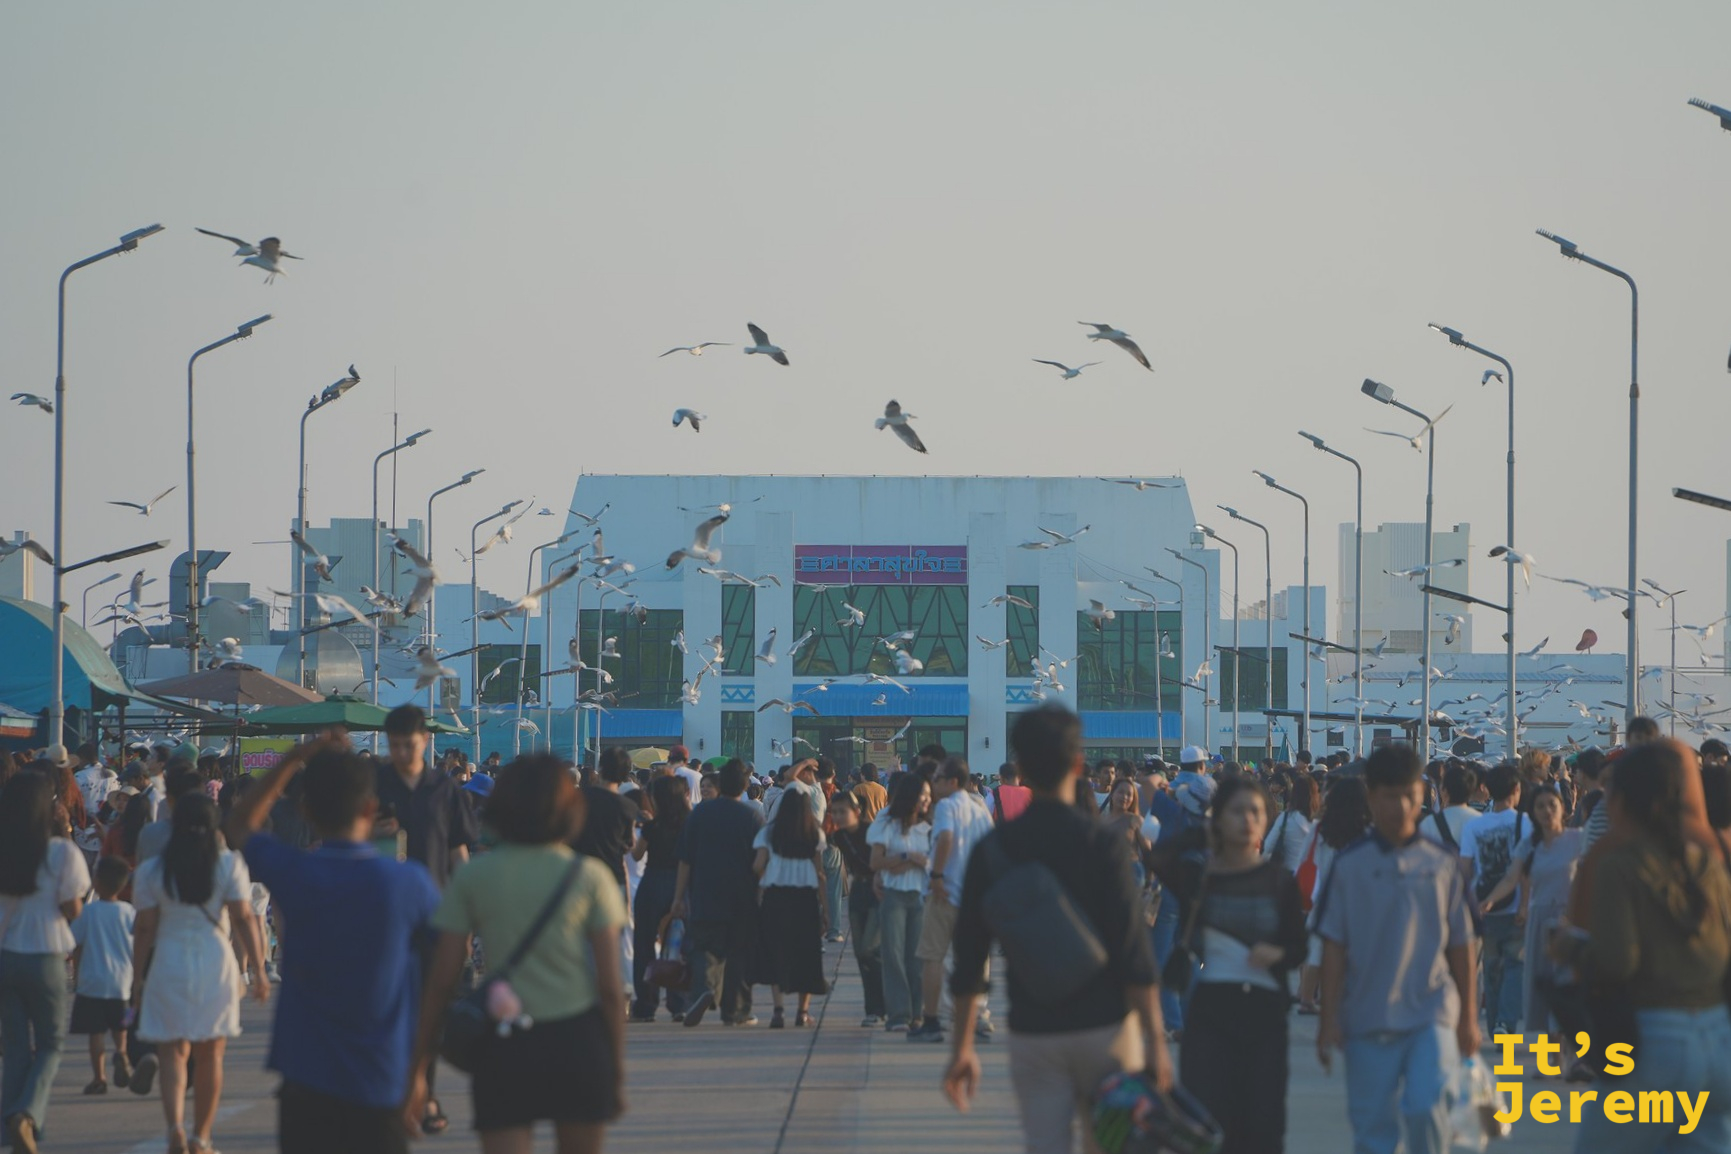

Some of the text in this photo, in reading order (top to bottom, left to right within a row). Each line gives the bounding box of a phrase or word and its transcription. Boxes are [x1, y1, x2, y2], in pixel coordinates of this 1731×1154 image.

[821, 549, 942, 580] ศาลาสุขใจ
[242, 748, 286, 774] จุดบริก
